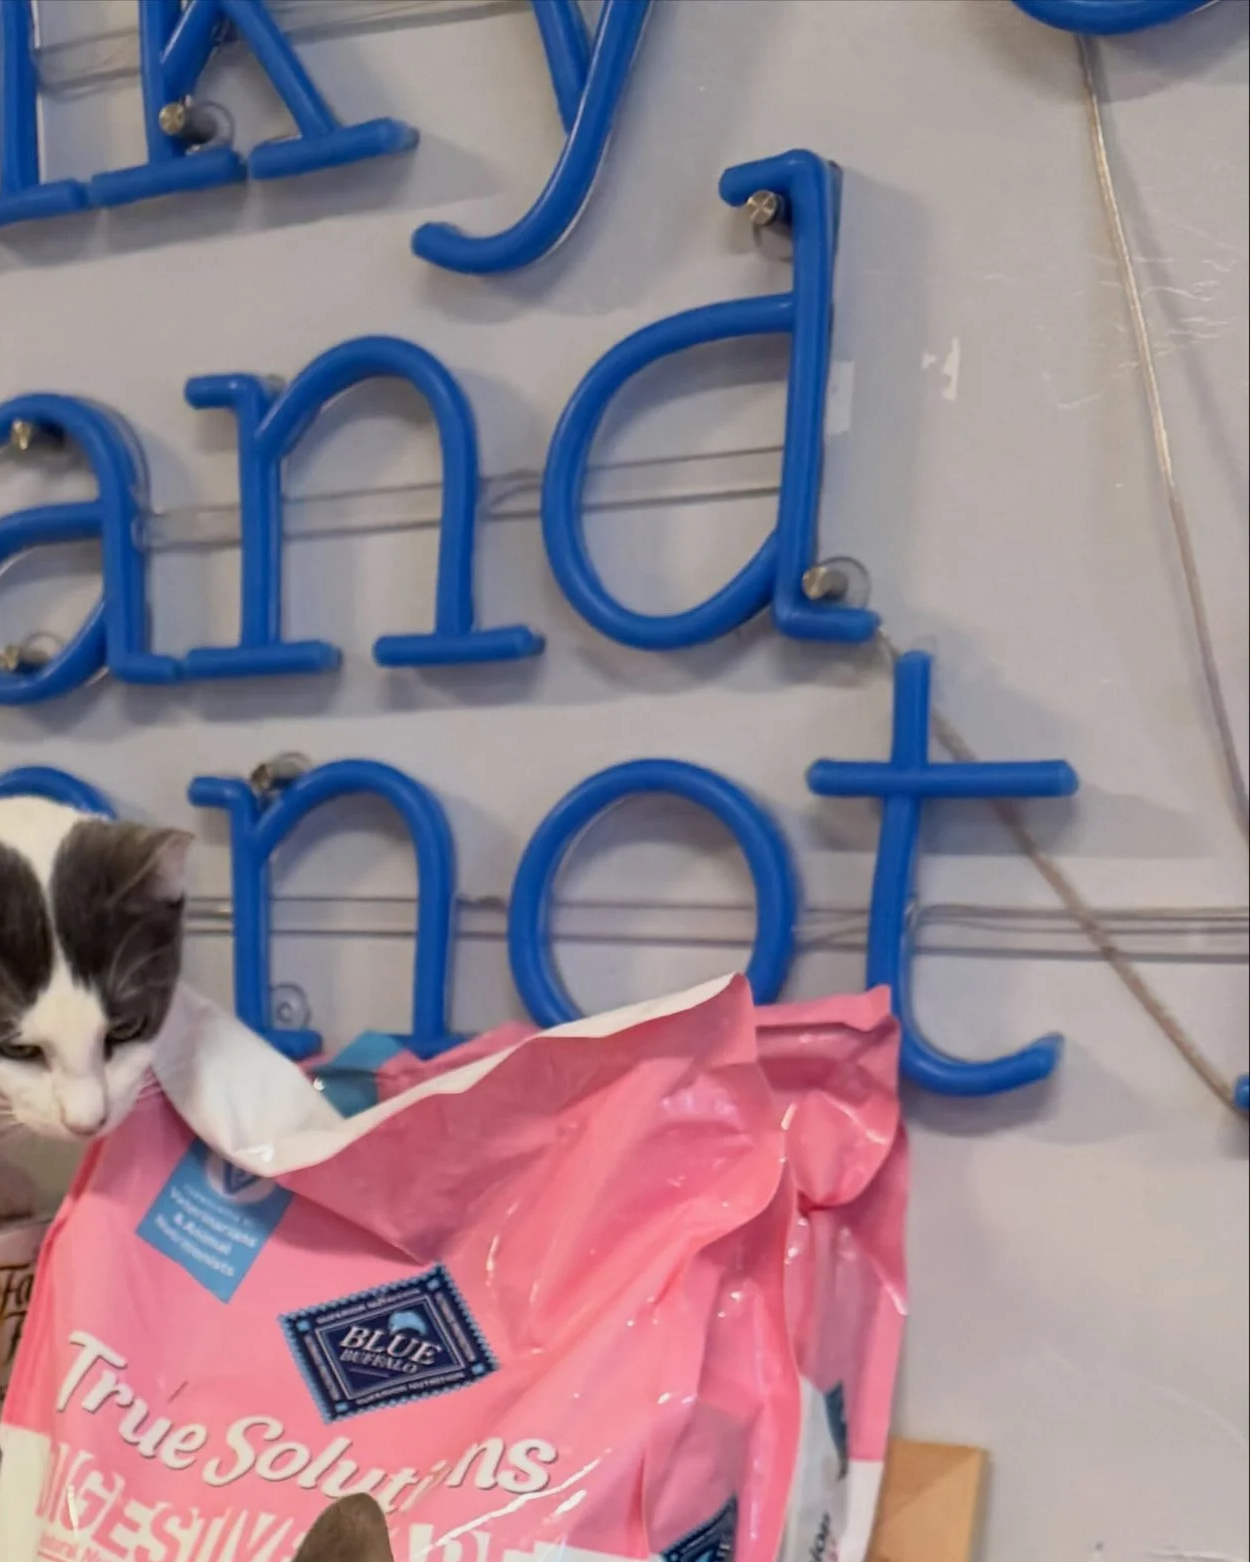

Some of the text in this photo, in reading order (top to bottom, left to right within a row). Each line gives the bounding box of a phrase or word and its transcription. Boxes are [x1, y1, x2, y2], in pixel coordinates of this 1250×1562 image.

[339, 1325, 442, 1365] BLUE
[339, 1349, 419, 1375] BUFFALO
[55, 1331, 208, 1470] True
[202, 1414, 559, 1514] Solutins
